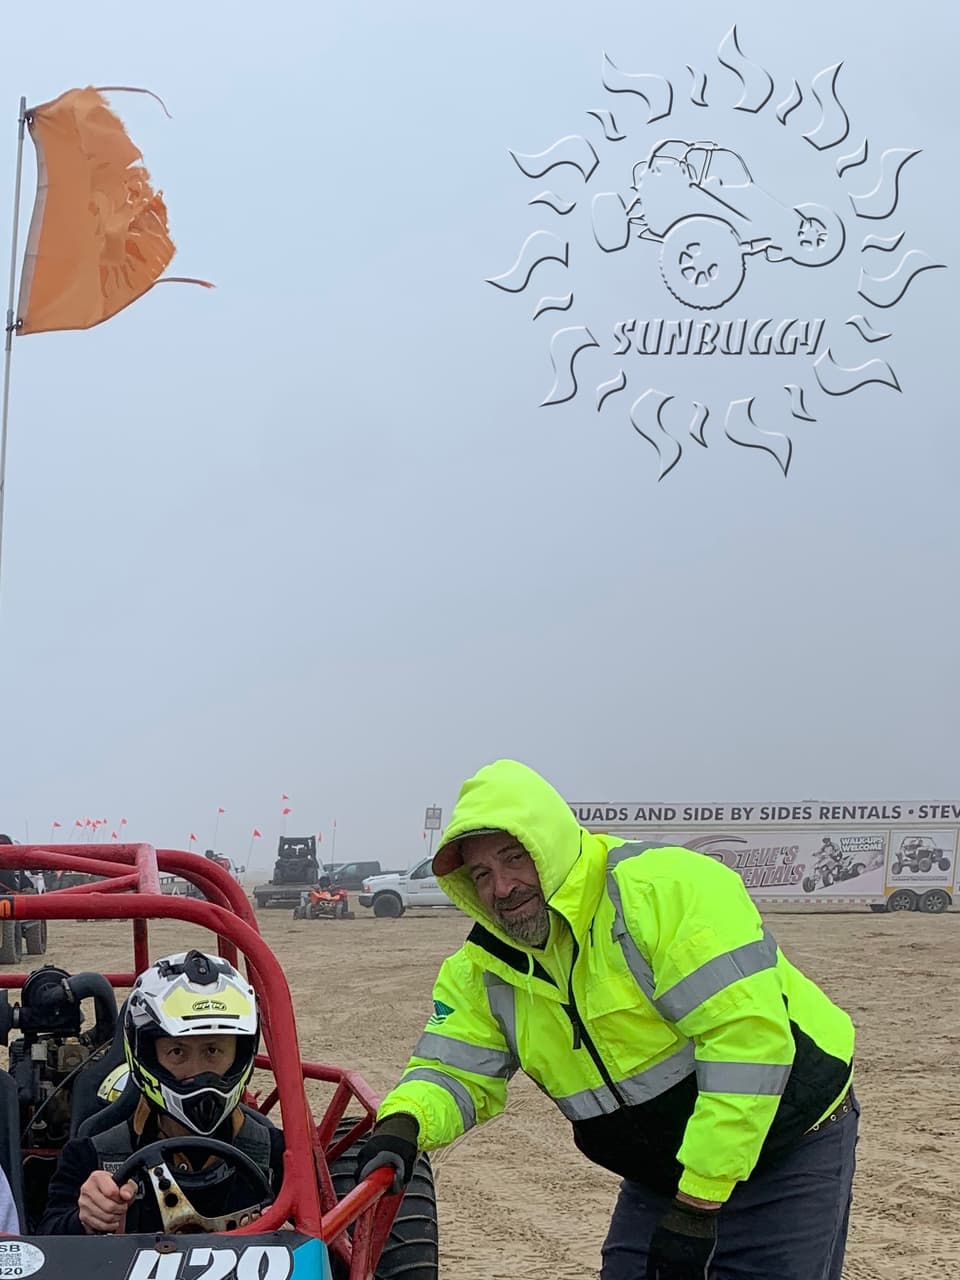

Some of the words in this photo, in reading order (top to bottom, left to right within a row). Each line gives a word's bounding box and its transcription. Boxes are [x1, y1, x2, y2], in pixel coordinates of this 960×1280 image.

[634, 807, 676, 821] AND
[682, 807, 723, 821] SIDE
[730, 807, 754, 821] BY
[759, 806, 812, 820] SIDES
[819, 805, 901, 820] RENTALS
[738, 864, 806, 887] ENTALS
